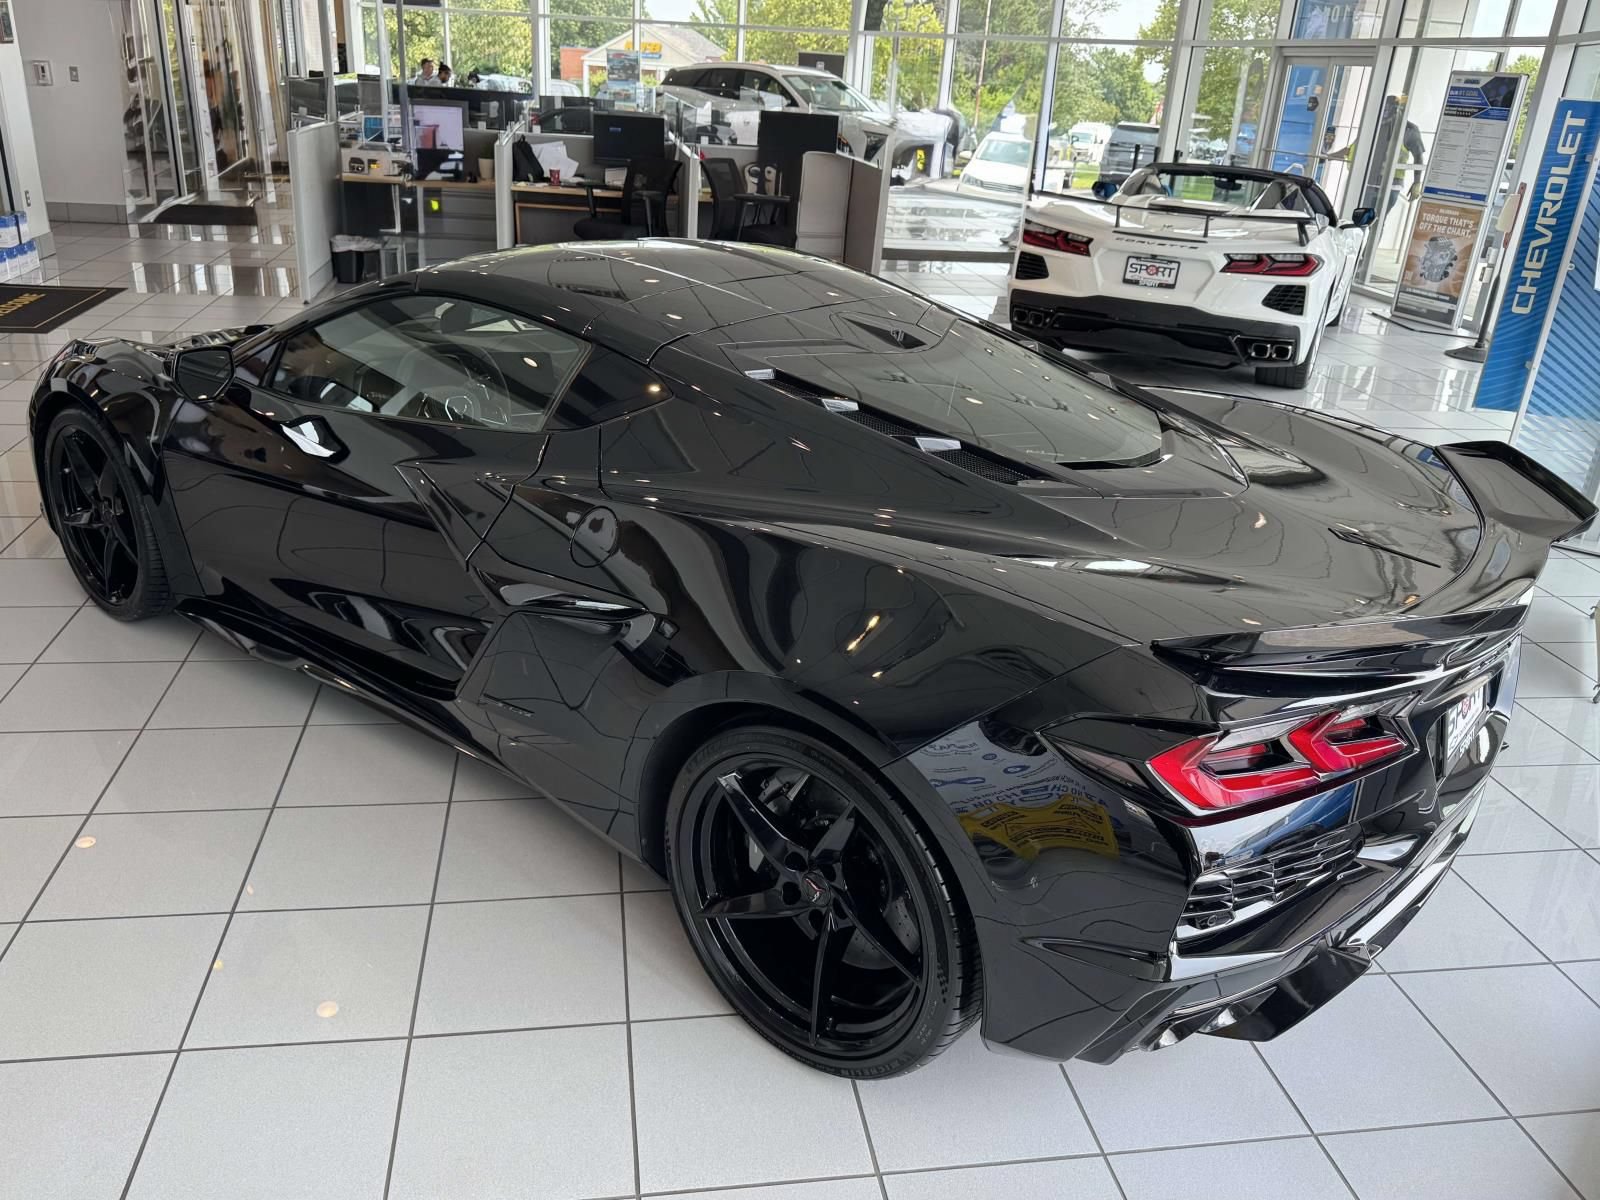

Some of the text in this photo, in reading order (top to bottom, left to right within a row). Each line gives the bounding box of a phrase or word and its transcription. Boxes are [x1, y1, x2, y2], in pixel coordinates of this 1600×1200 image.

[1511, 110, 1586, 315] CHEVROLET
[1419, 222, 1433, 231] OFF
[1433, 224, 1447, 233] THE
[1422, 213, 1475, 229] TORQUE THAT'S
[1115, 236, 1199, 250] CORVETTE
[1129, 262, 1176, 278] SPORT
[841, 1060, 903, 1077] MICHELIN
